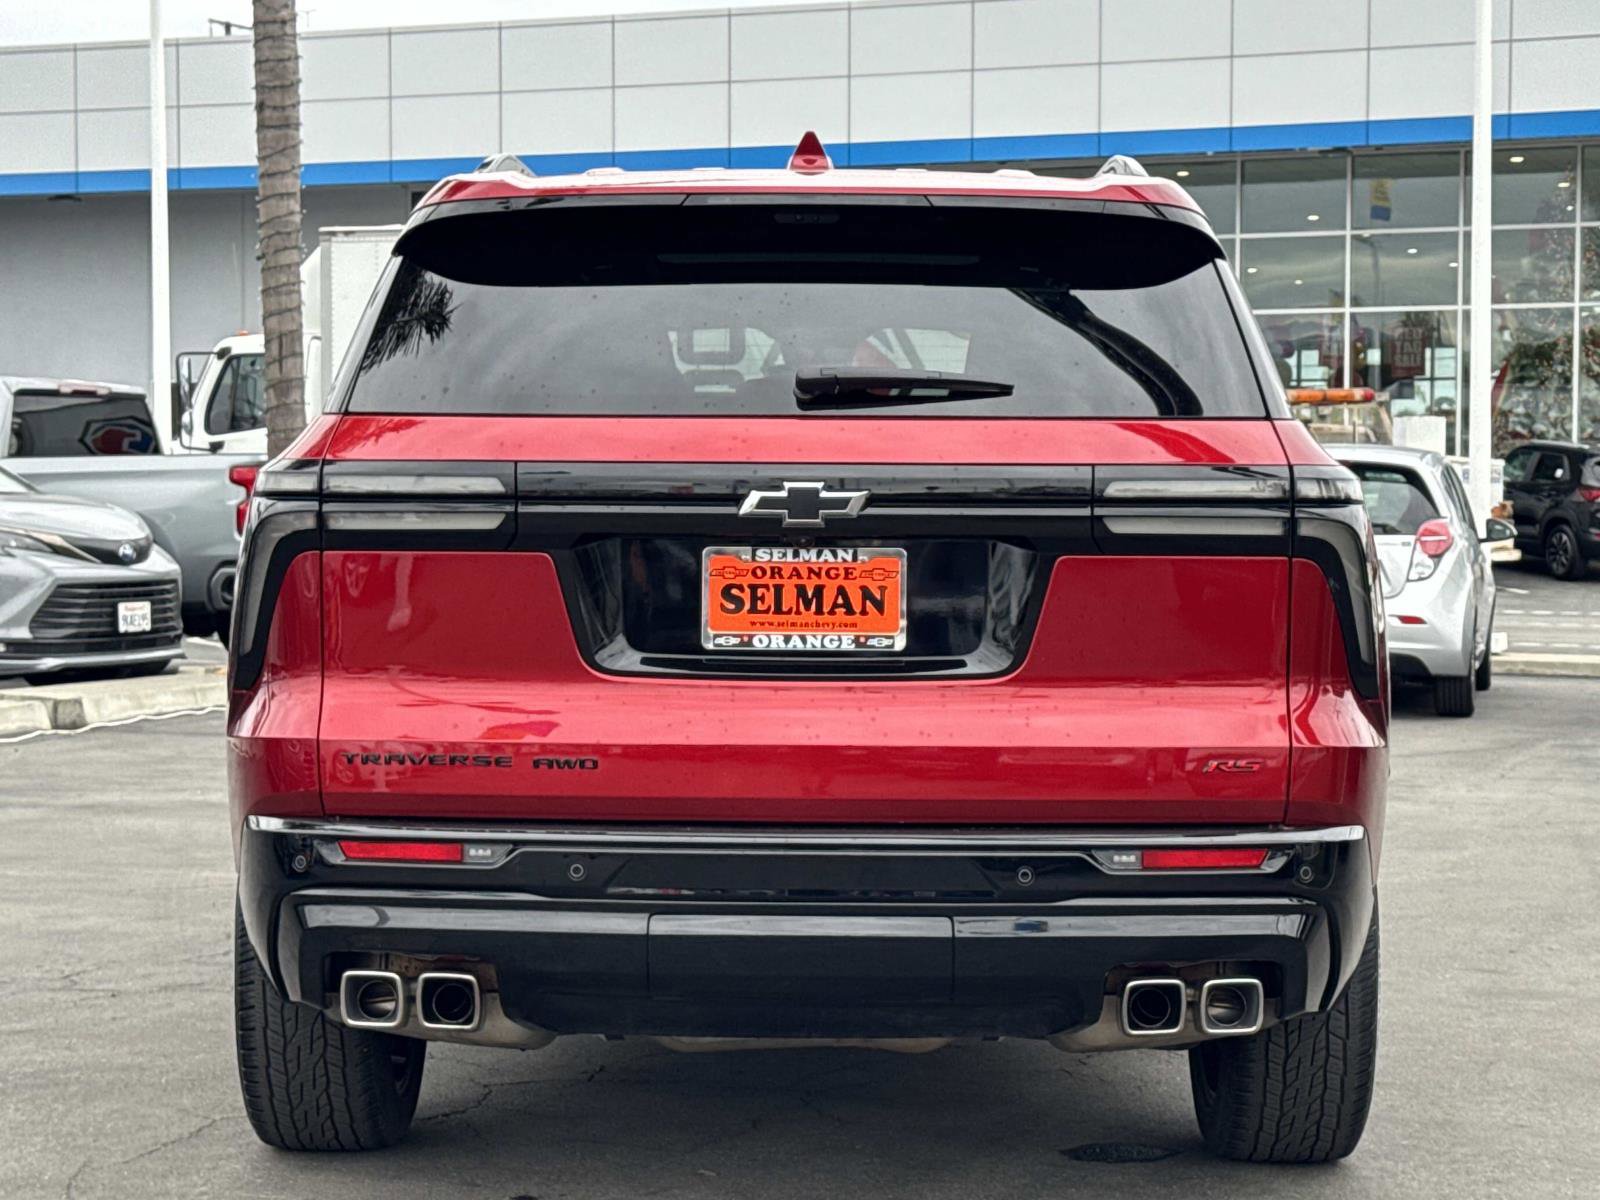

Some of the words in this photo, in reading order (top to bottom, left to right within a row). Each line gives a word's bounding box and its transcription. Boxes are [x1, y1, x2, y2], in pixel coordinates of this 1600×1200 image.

[755, 548, 853, 563] SELMAN
[750, 565, 858, 580] ORANGE
[720, 583, 888, 616] SELMAN
[749, 619, 858, 630] www.selmanchevy.com
[752, 634, 855, 649] ORANGE
[341, 753, 513, 768] TRAVERSE
[532, 757, 600, 770] AWD
[1201, 758, 1264, 775] RS
